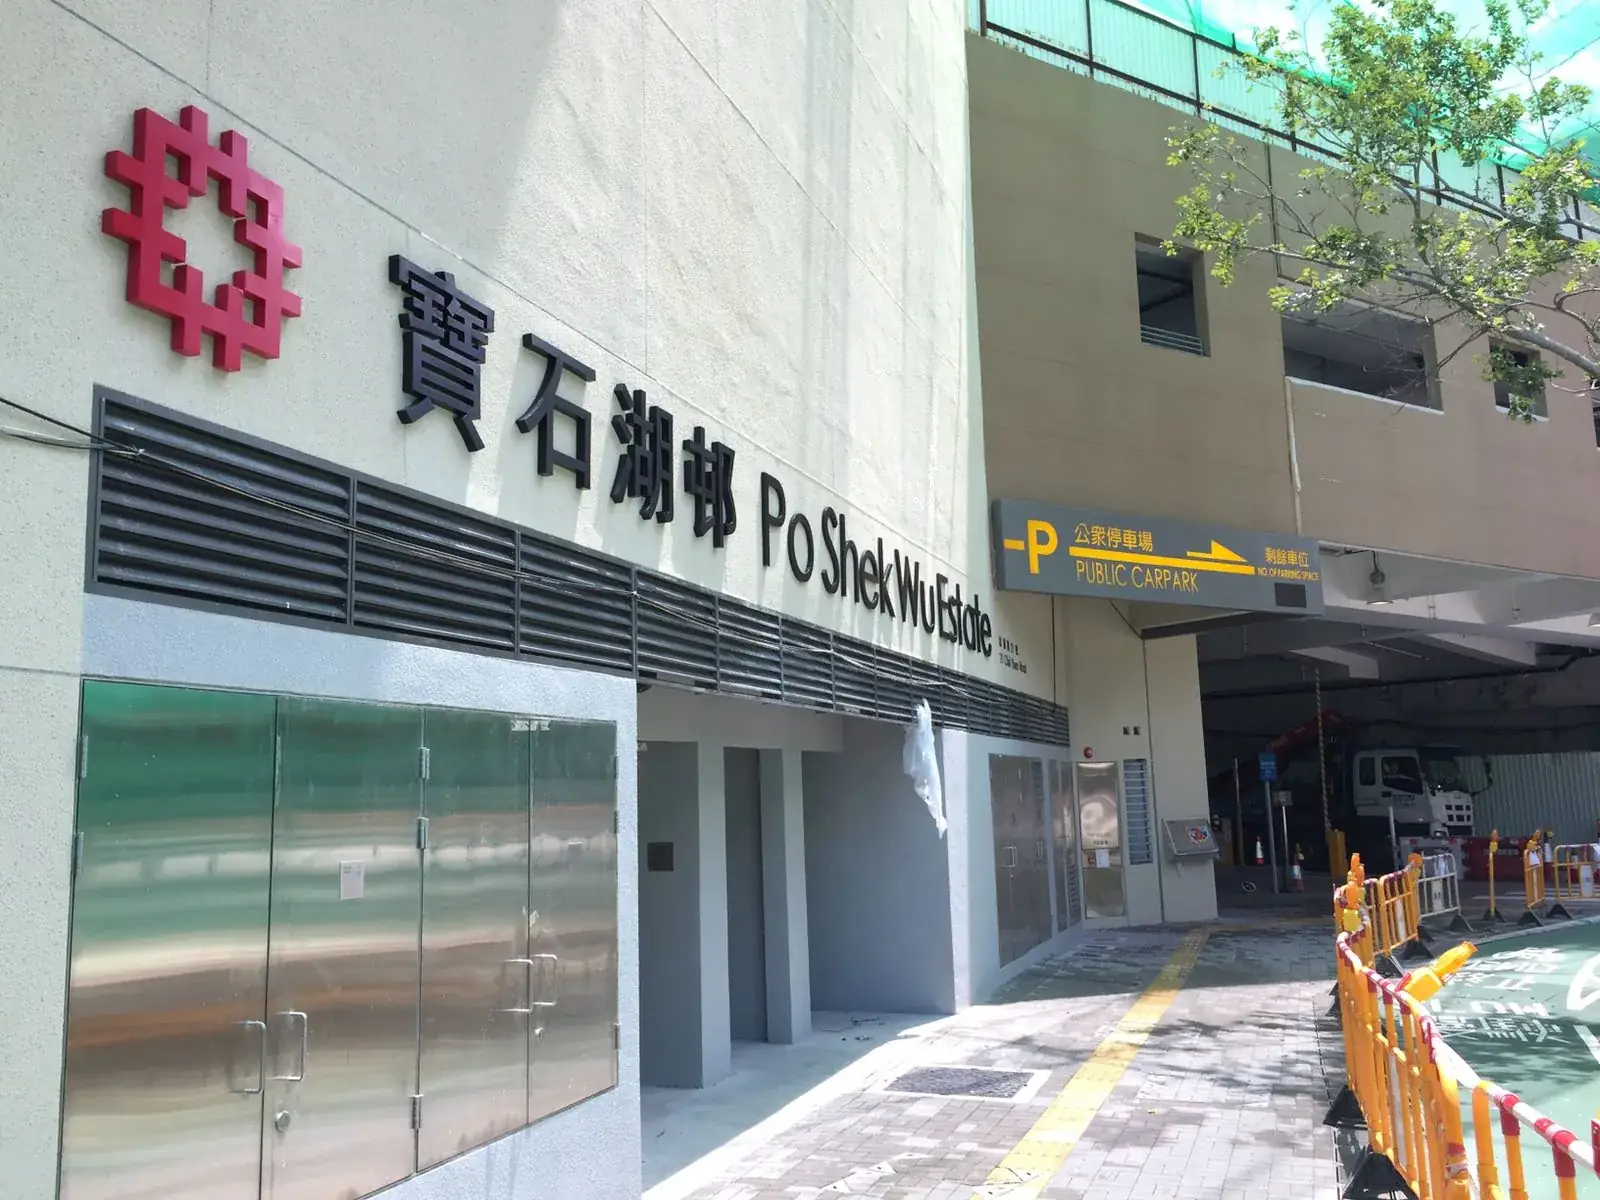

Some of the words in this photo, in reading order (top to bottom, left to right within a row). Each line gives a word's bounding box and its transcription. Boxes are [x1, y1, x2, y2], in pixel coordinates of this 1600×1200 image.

[388, 254, 737, 548] 寶石湖邨
[760, 472, 815, 582] Po
[820, 506, 895, 618] Shek
[892, 549, 936, 633] Wu
[936, 574, 992, 658] Estate
[1027, 519, 1058, 574] P
[1076, 560, 1126, 586] PUBLIC
[1131, 568, 1199, 592] CARPARK
